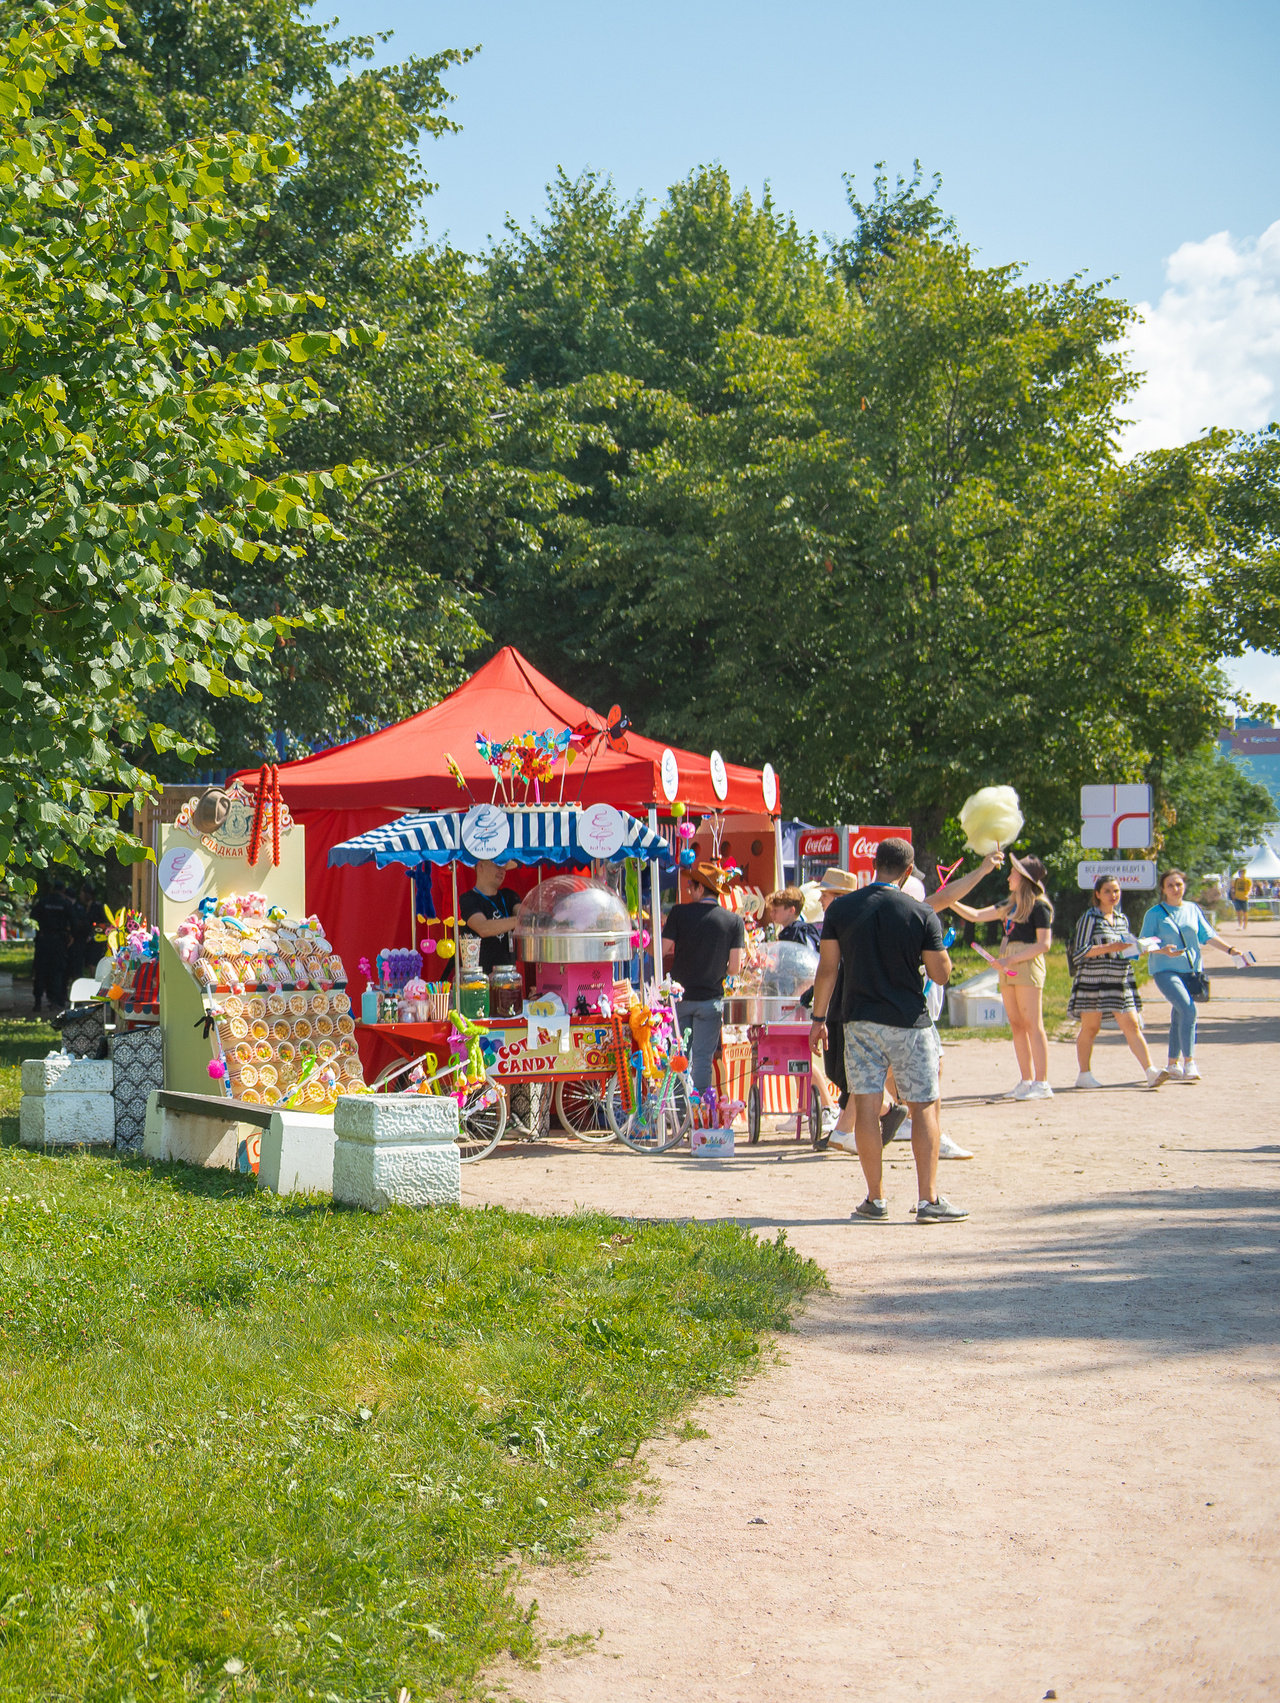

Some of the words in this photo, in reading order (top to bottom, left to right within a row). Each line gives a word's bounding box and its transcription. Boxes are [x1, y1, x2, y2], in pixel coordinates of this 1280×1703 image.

[201, 835, 243, 857] СЛАДКАЯ
[246, 836, 267, 856] ВА
[984, 1008, 996, 1020] 18
[498, 1030, 551, 1060] COTN
[572, 1029, 607, 1049] POP
[586, 1051, 616, 1067] COR
[726, 1047, 751, 1058] ПОПКОР
[498, 1056, 558, 1074] CANDY
